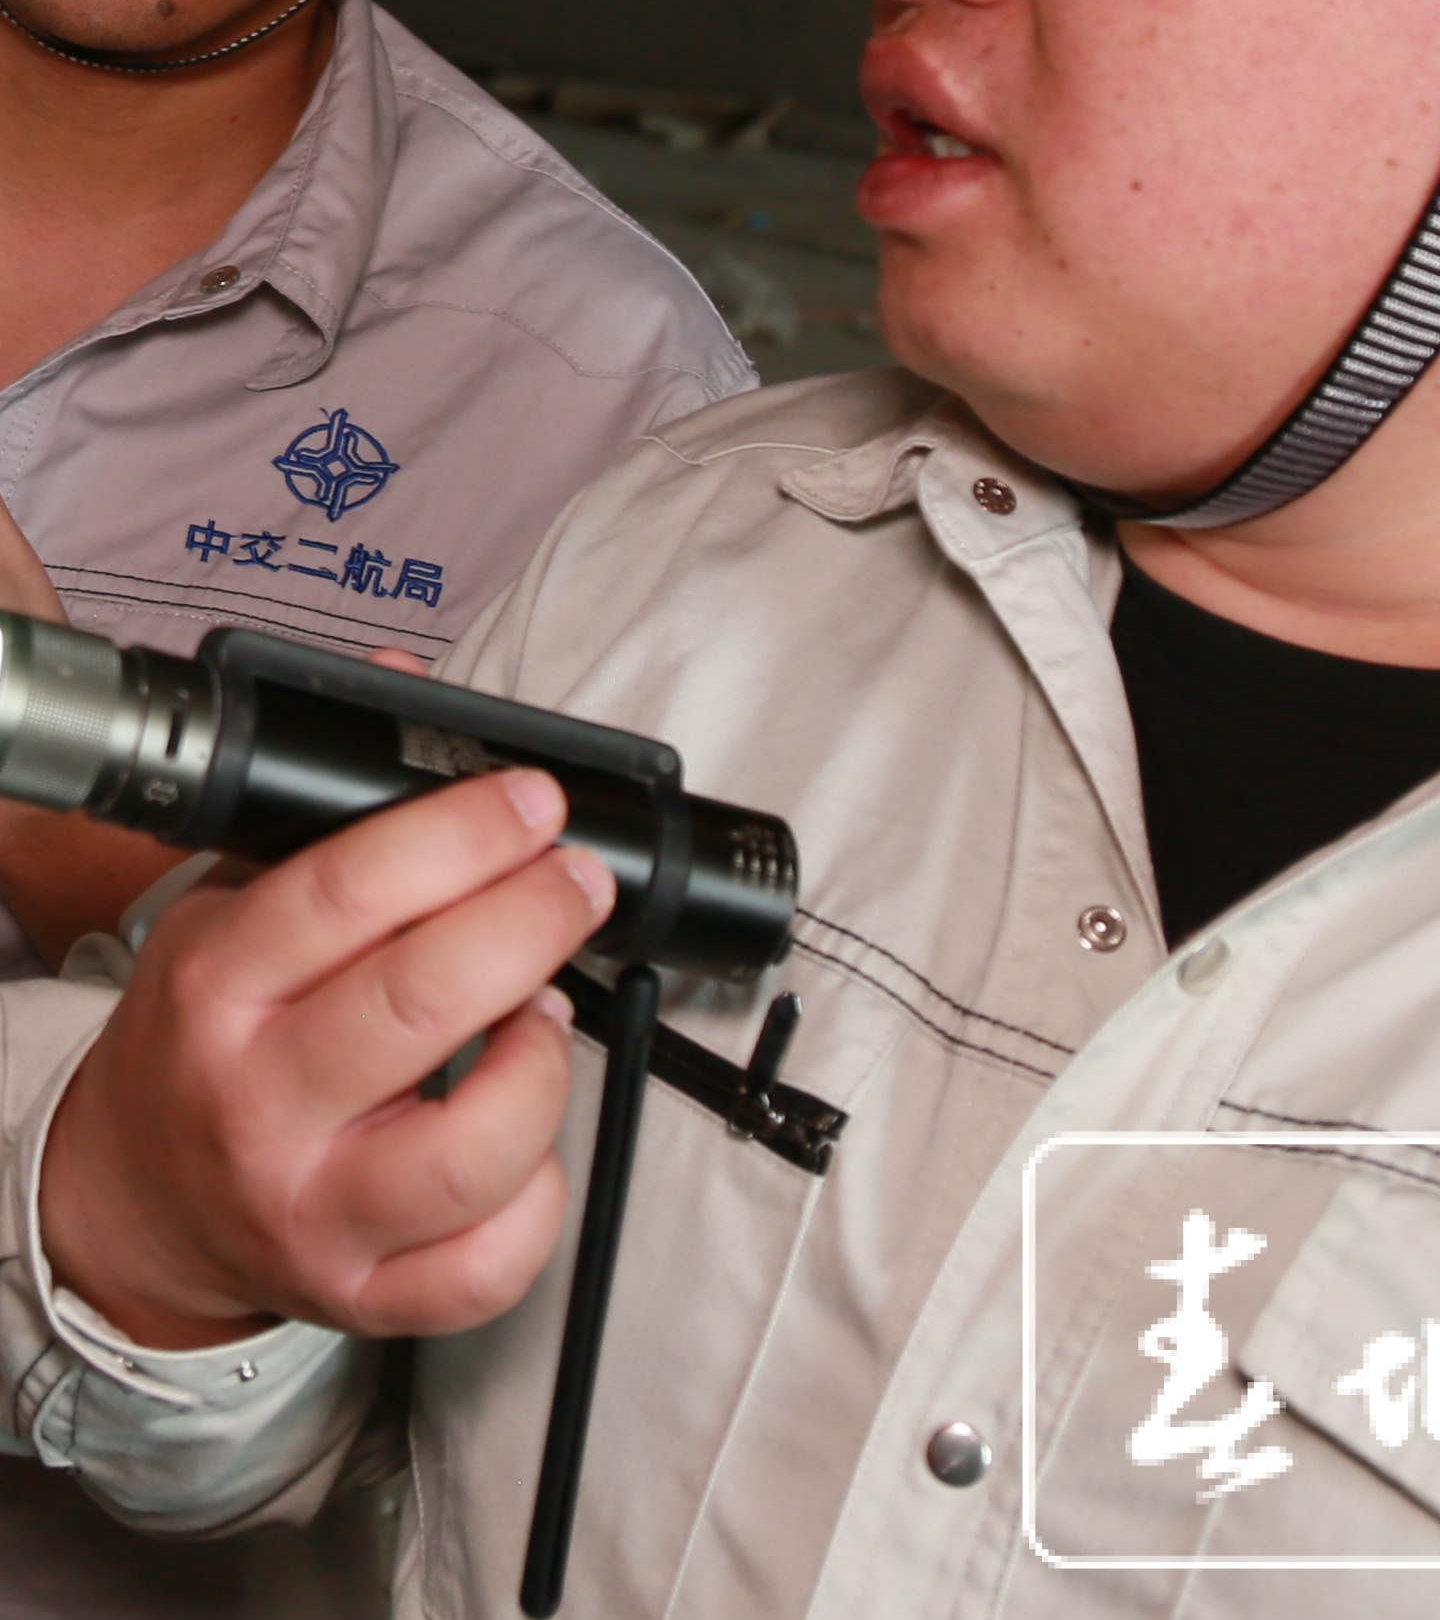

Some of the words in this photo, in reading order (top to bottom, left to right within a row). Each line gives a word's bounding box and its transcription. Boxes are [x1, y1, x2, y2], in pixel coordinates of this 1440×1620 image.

[185, 518, 445, 609] 中交二航局
